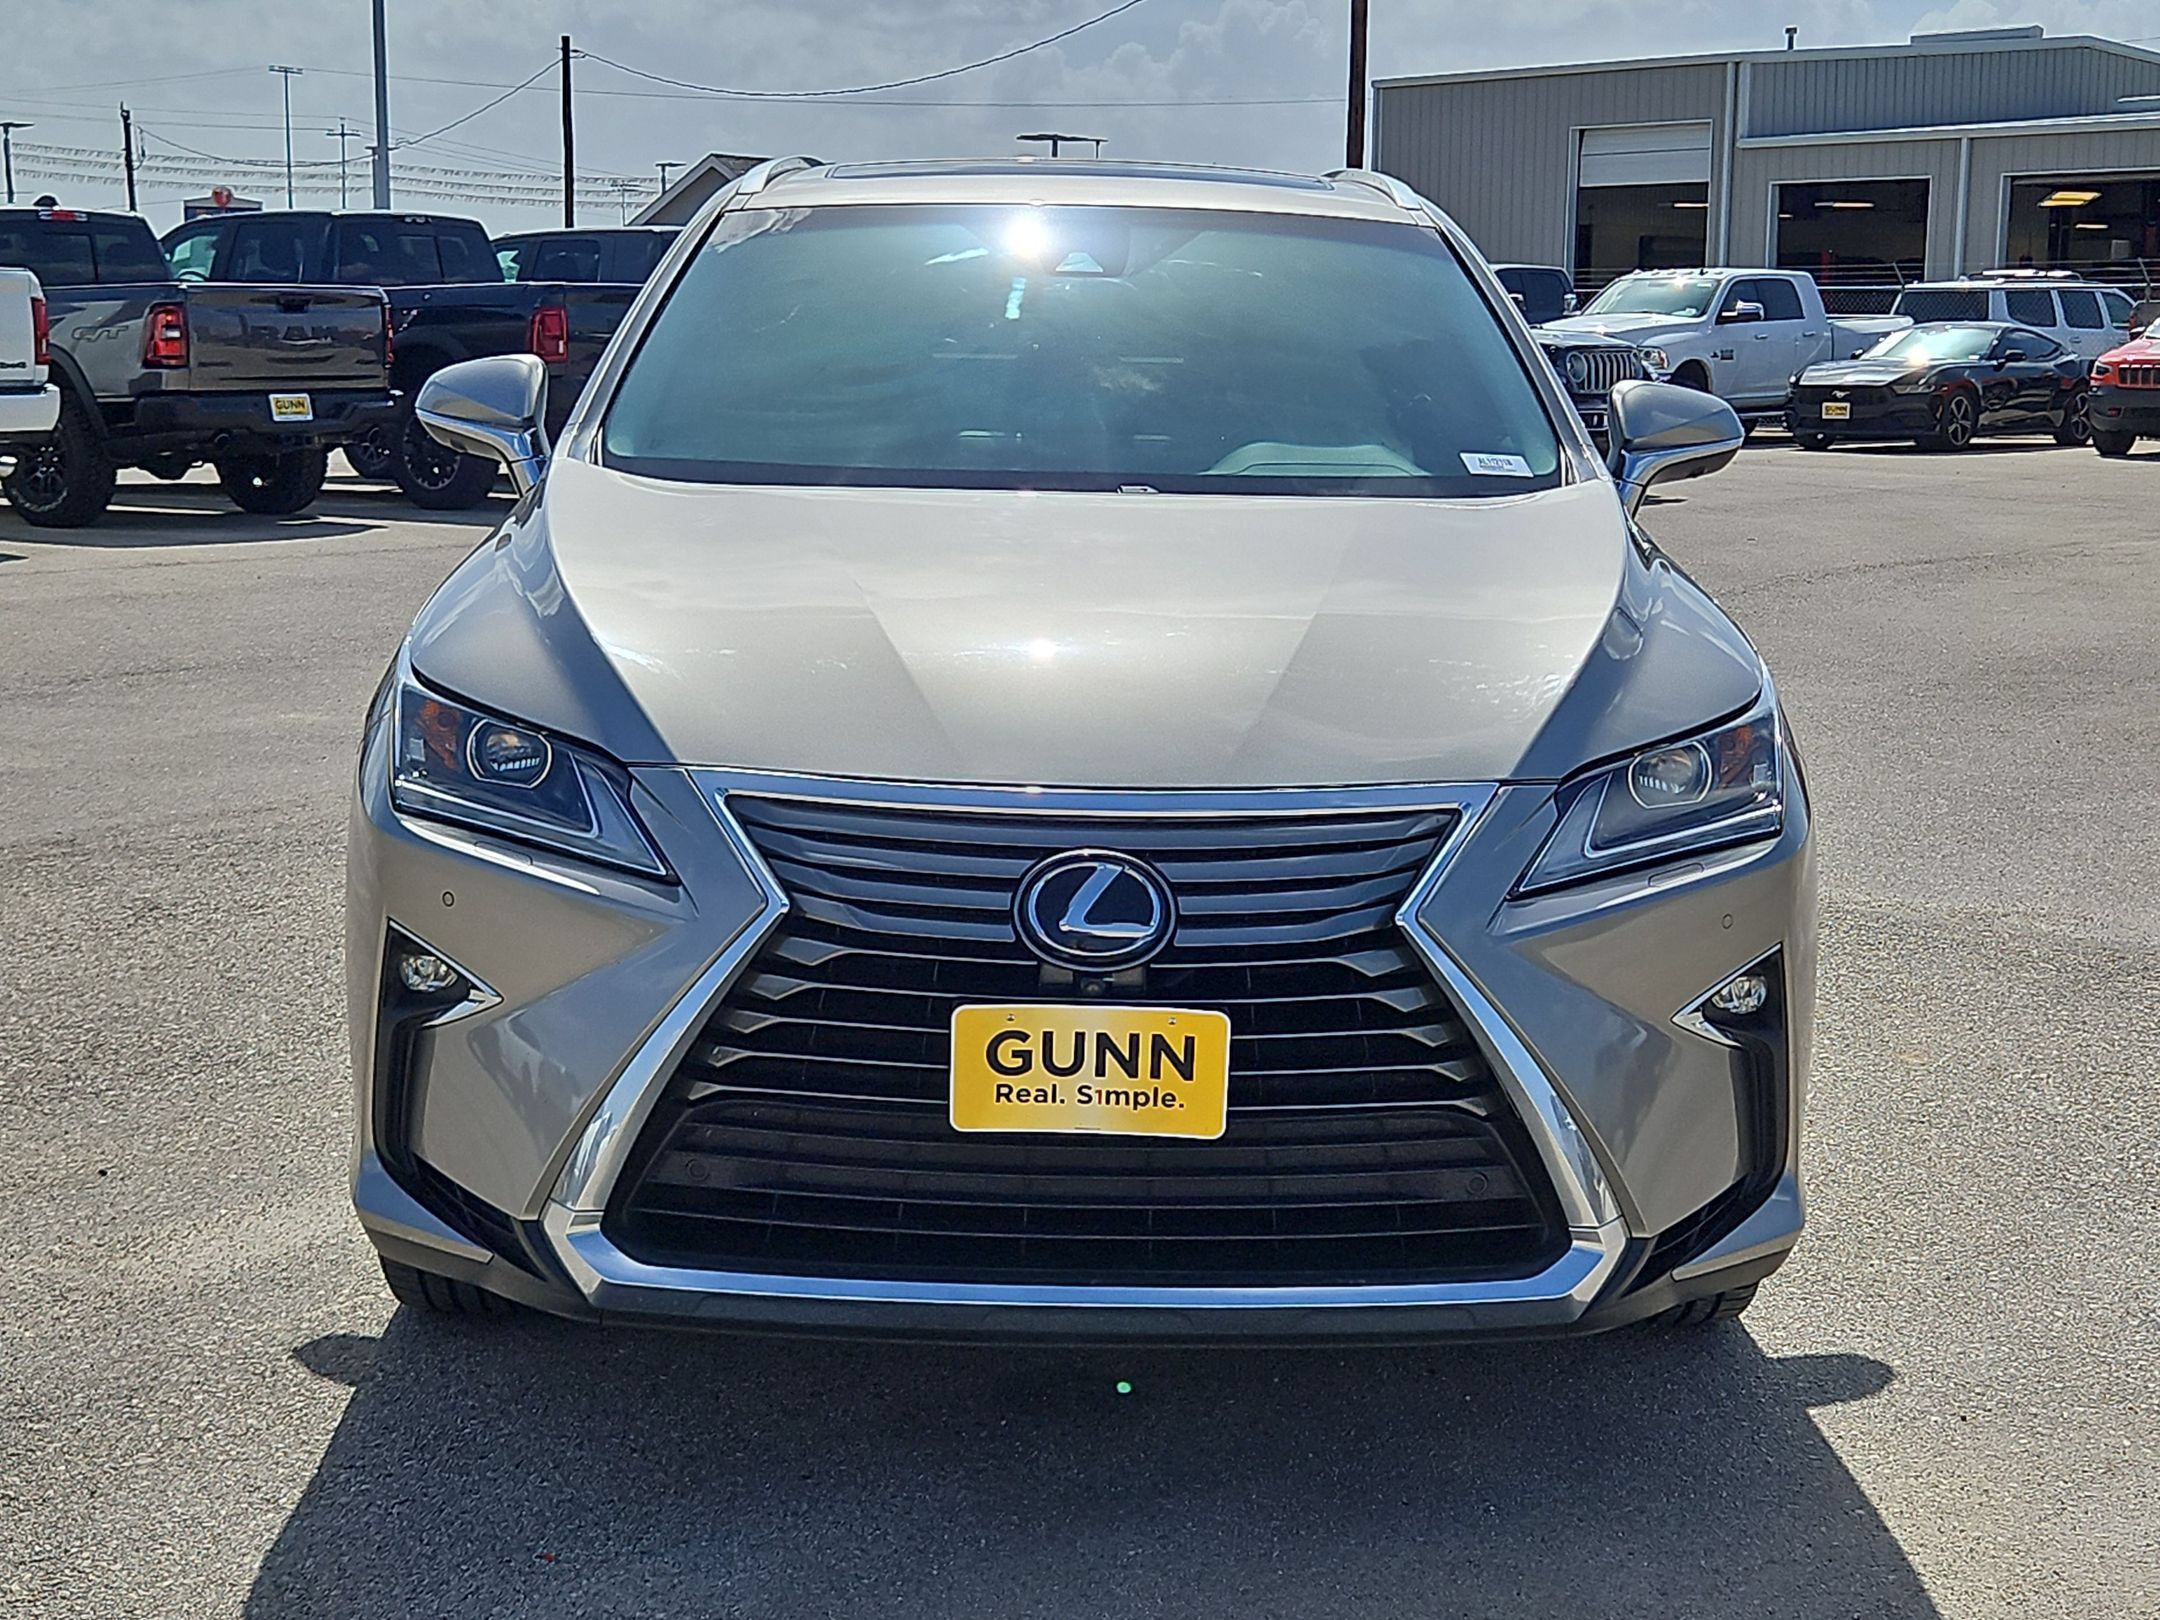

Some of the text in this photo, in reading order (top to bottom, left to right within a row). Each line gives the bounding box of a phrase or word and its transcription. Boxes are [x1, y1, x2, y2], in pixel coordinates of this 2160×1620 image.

[275, 399, 306, 410] GUNN
[985, 1029, 1197, 1082] GUNN
[995, 1083, 1066, 1105] Real.
